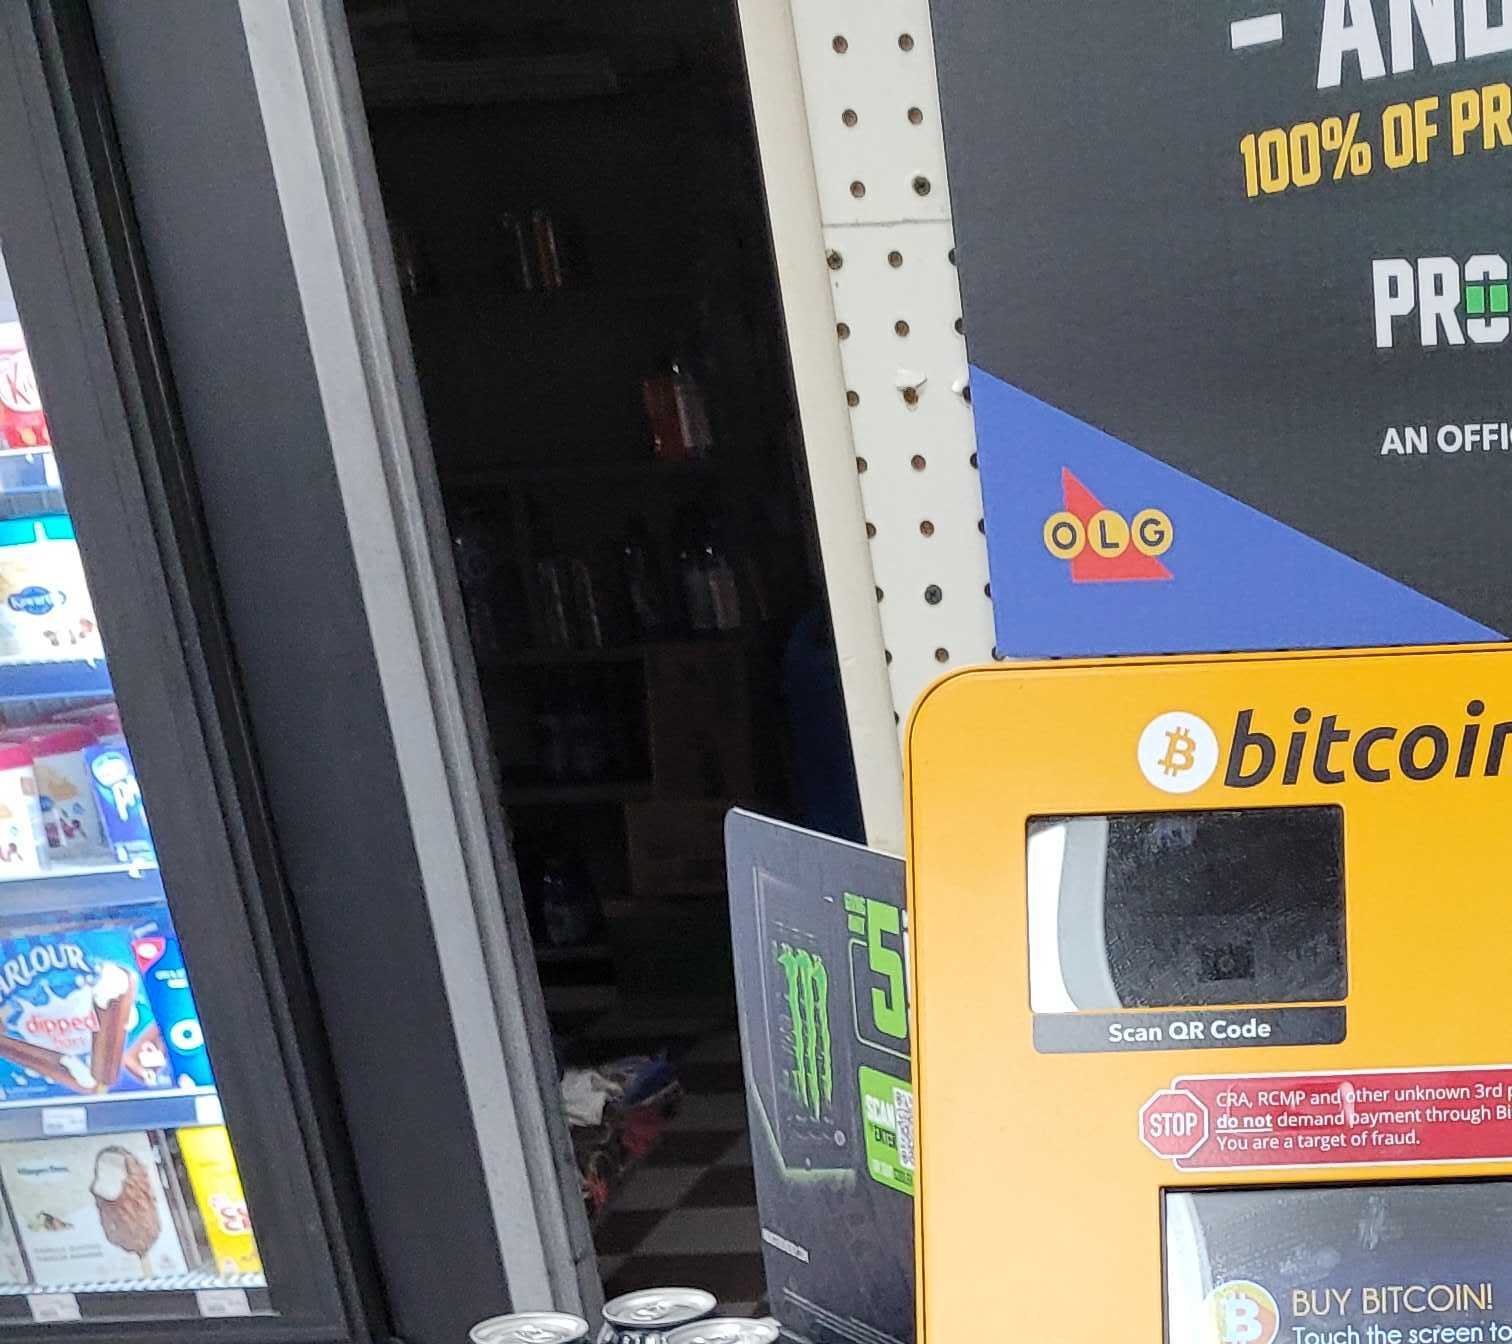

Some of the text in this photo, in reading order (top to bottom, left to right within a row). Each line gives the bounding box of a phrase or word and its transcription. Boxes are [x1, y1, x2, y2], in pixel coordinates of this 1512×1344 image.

[1240, 112, 1372, 198] 100%
[1381, 96, 1439, 169] OF
[1380, 426, 1428, 456] AN
[1044, 509, 1173, 558] OLG
[1108, 1018, 1272, 1043] Scan QR Code
[1215, 1091, 1254, 1107] CRA,
[1258, 1091, 1306, 1106] RCMP
[1310, 1090, 1341, 1105] and
[1345, 1088, 1390, 1103] other
[1393, 1085, 1470, 1101] unknown
[1474, 1083, 1503, 1099] 3rd
[1150, 1113, 1197, 1138] STOP
[1216, 1112, 1240, 1128] do
[1243, 1113, 1272, 1128] not
[1277, 1110, 1345, 1127] demand
[1349, 1108, 1422, 1129] payment
[1425, 1105, 1492, 1124] through
[1216, 1129, 1421, 1151] You are a target of fraud.
[1292, 1283, 1493, 1317] BUY BITCOIN!
[1409, 1325, 1484, 1344] screen
[1489, 1322, 1512, 1342] to
